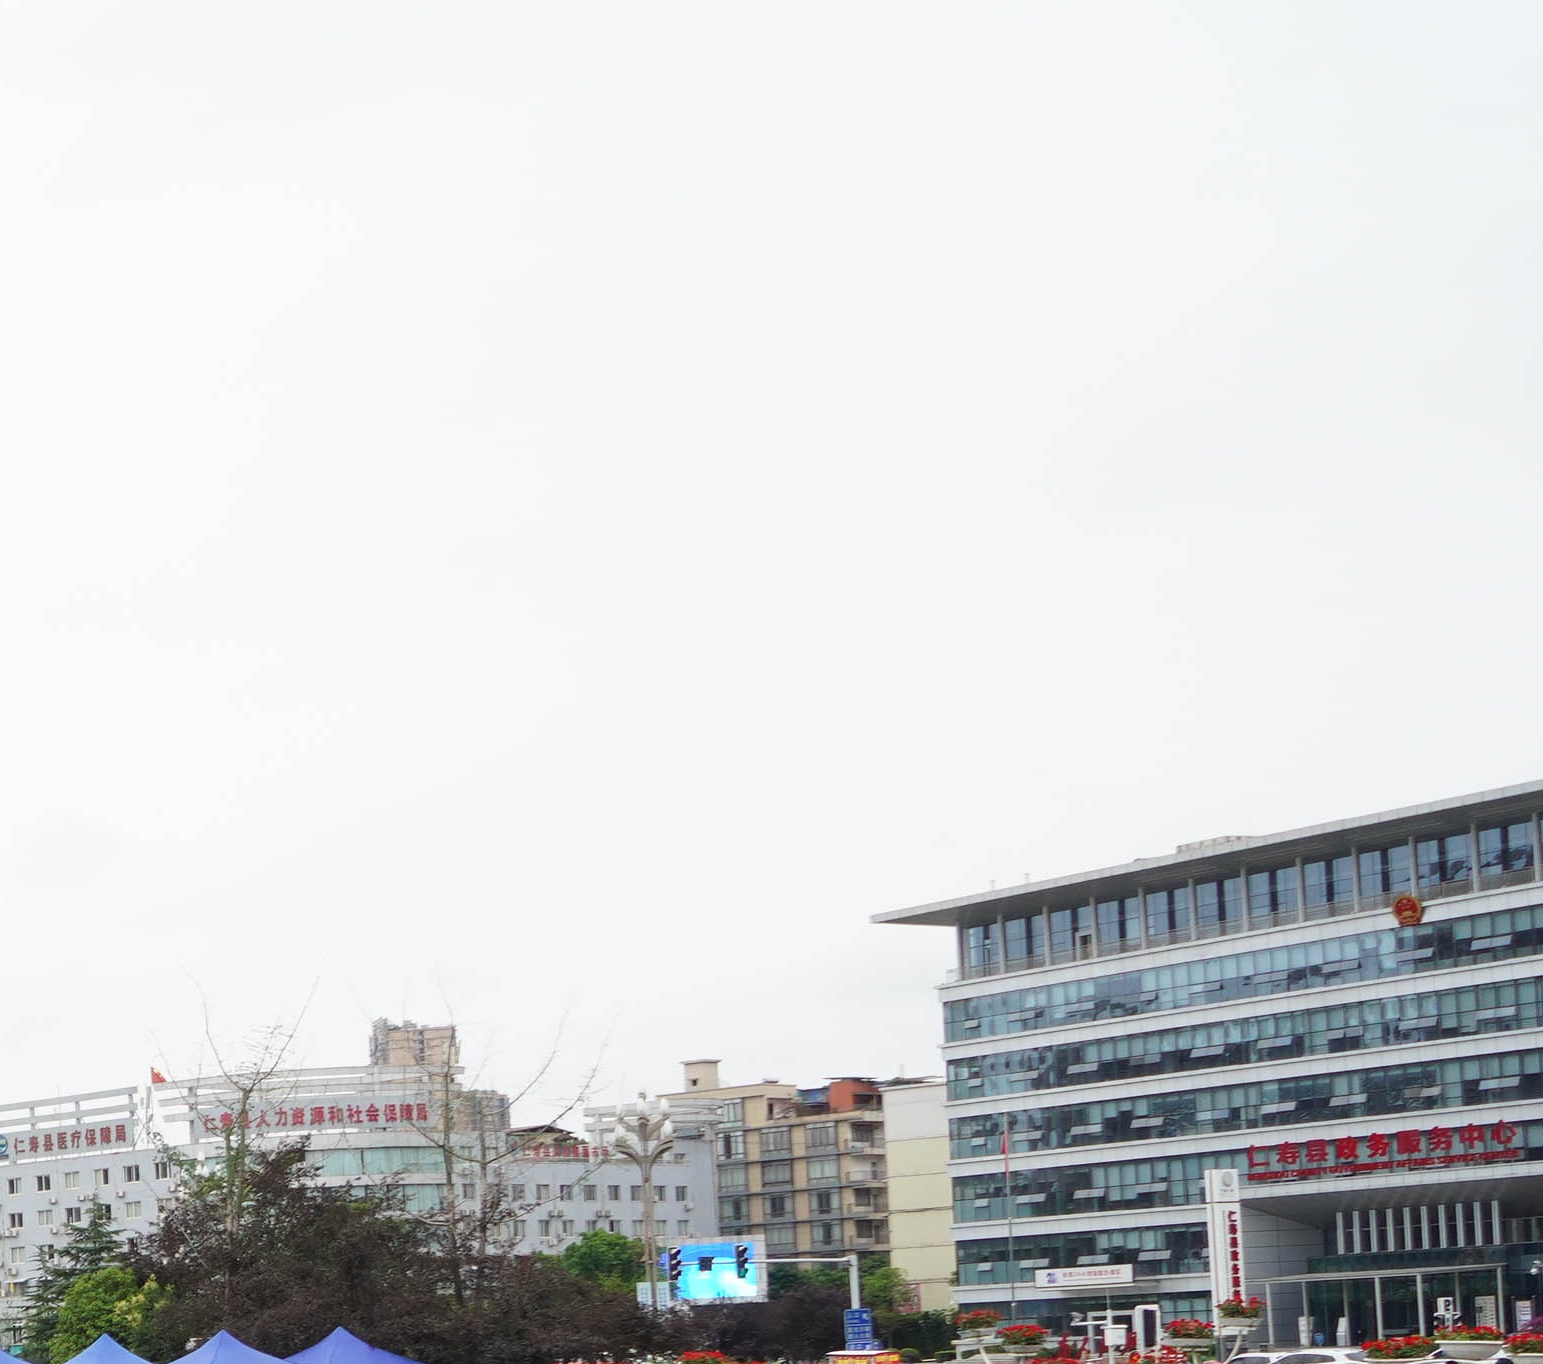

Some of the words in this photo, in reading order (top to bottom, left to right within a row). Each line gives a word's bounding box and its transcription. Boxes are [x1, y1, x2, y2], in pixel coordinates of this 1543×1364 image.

[13, 1124, 127, 1155] 仁寿县医疗保障局
[1246, 1119, 1518, 1168] 仁寿县政务服务中心
